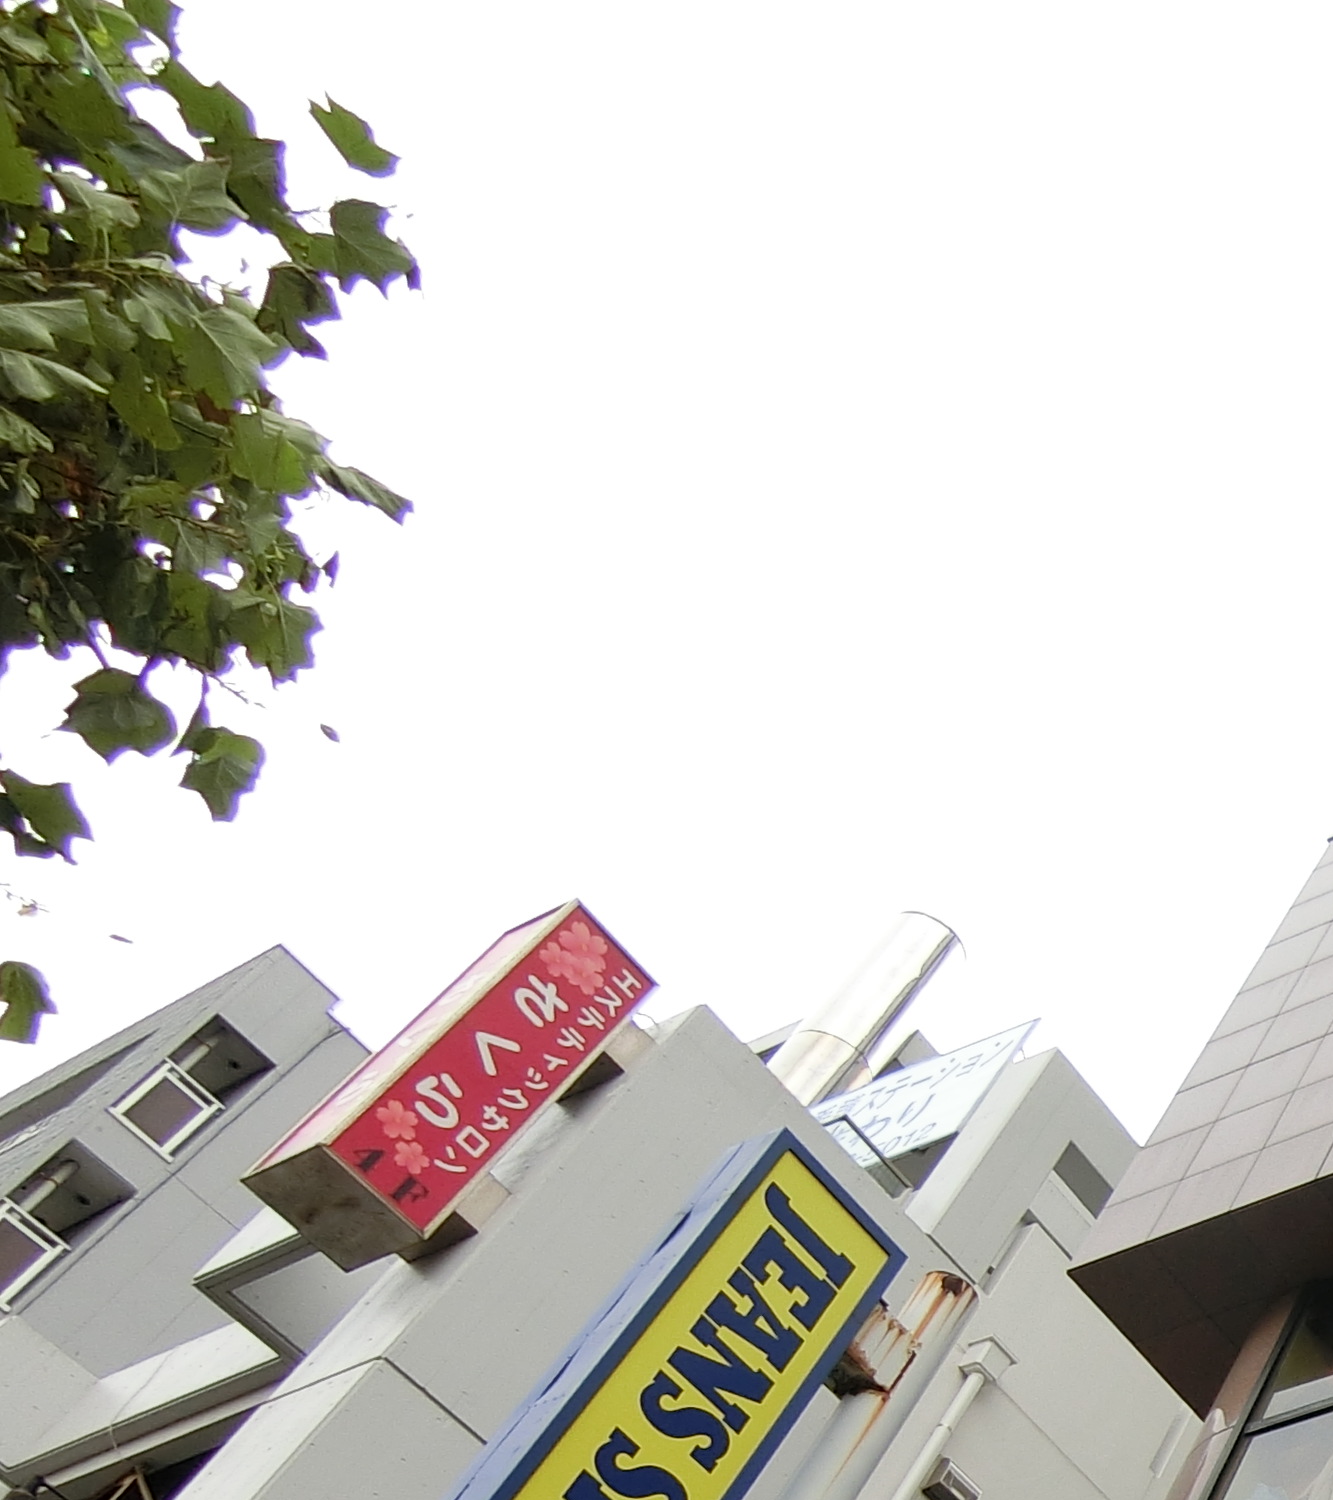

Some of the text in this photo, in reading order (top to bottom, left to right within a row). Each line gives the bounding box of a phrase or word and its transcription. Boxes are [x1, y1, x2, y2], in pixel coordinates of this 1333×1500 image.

[415, 974, 569, 1128] さくら
[434, 968, 642, 1172] エステティックサロン
[639, 1183, 856, 1475] JEANS
